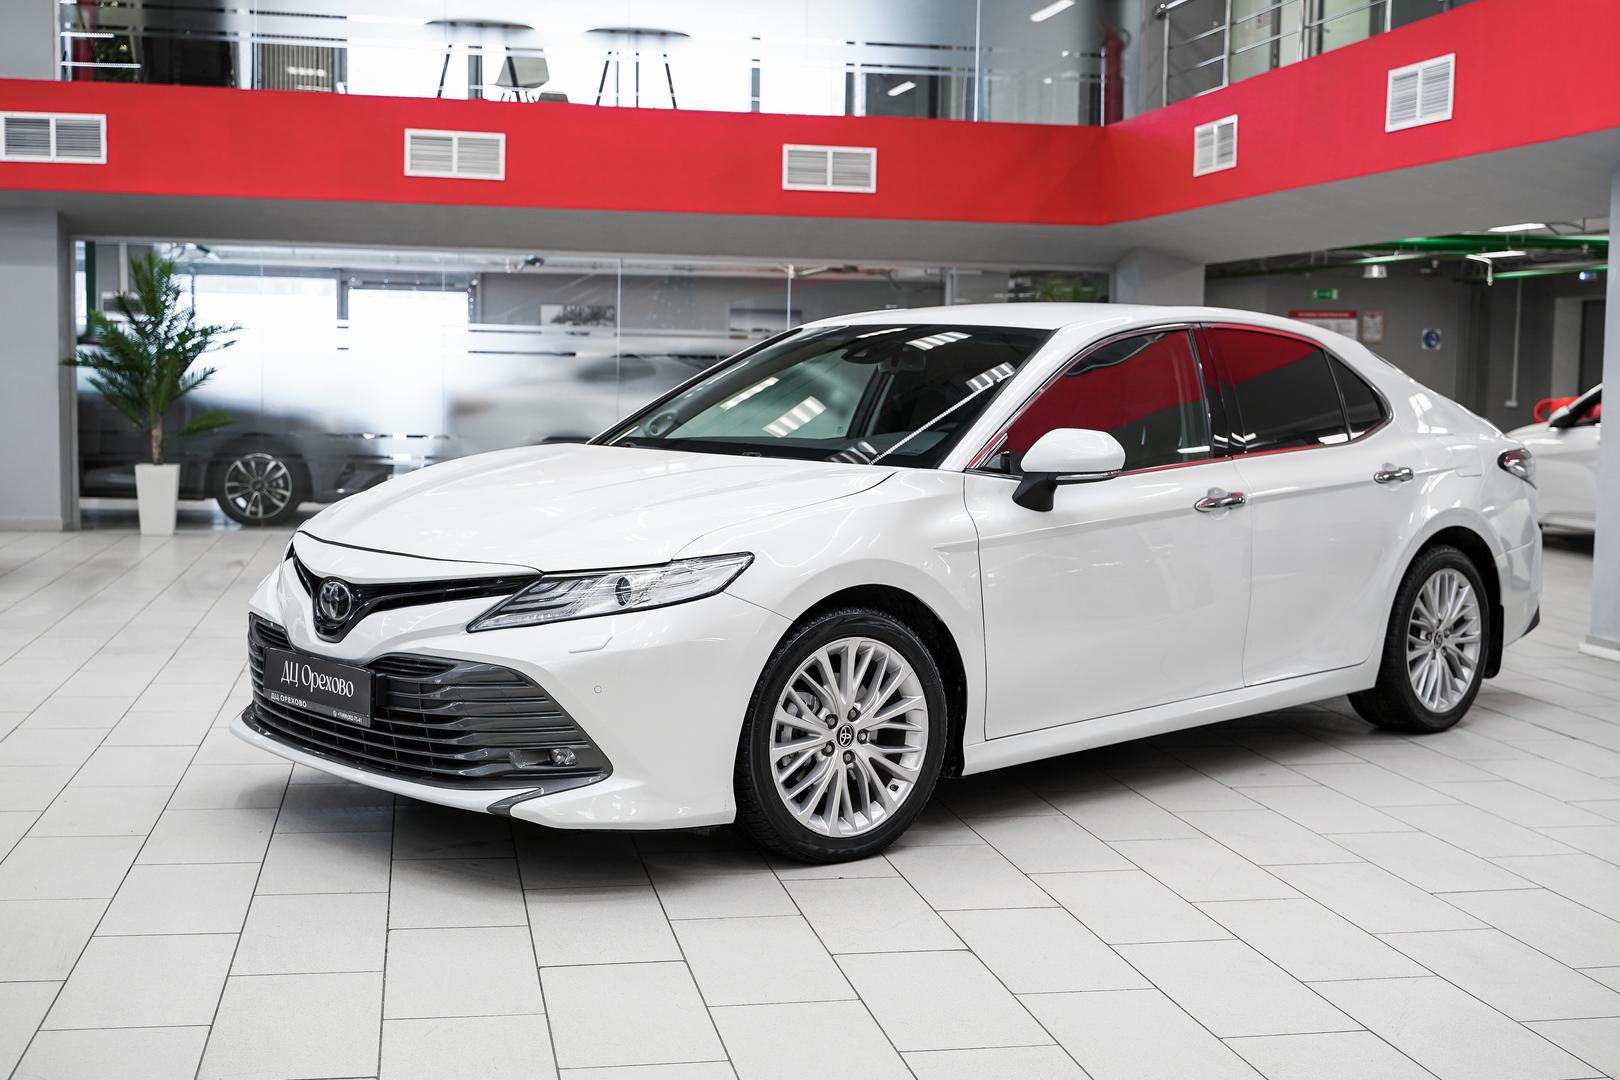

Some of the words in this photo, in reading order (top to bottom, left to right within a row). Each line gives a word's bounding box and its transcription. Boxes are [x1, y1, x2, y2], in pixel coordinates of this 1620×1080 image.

[281, 660, 299, 687] ДЦ
[301, 664, 354, 698] Орехово
[271, 692, 280, 702] ДЦ
[280, 694, 307, 708] ОРЕХОВО
